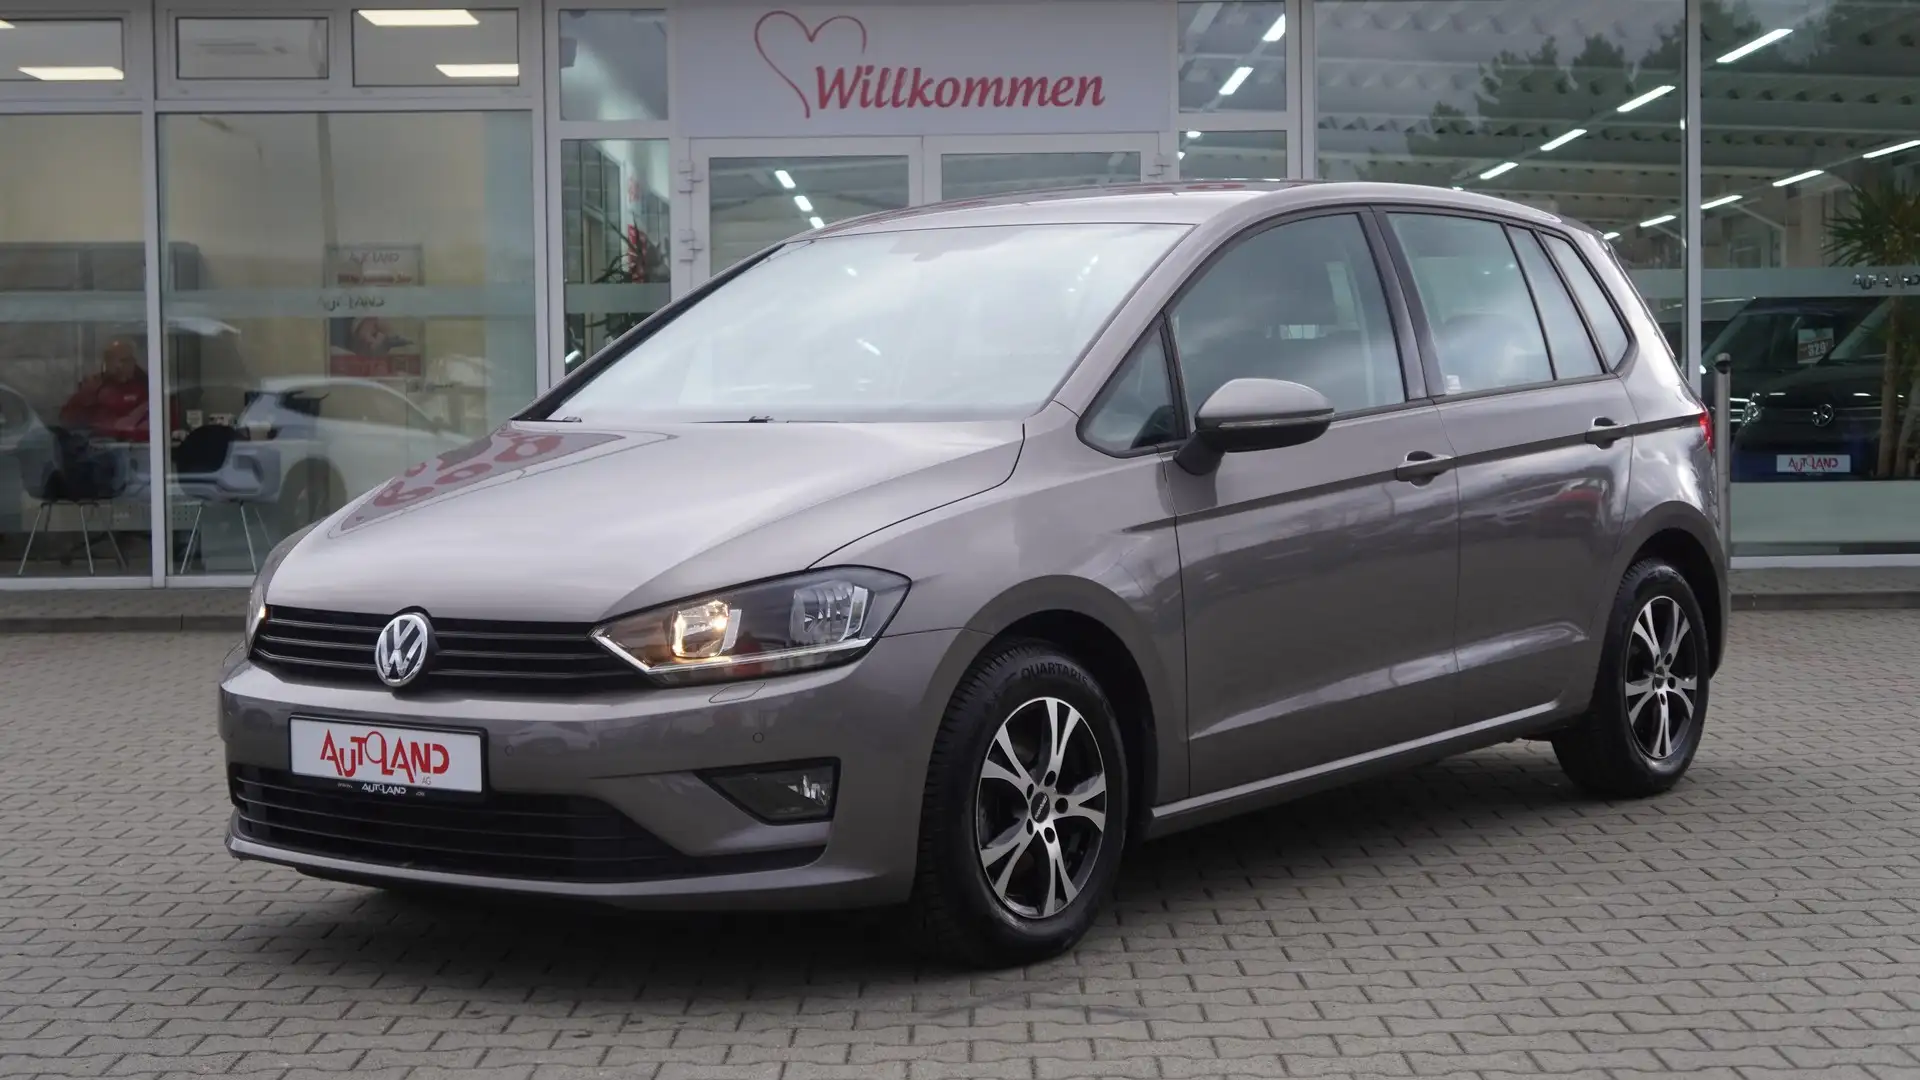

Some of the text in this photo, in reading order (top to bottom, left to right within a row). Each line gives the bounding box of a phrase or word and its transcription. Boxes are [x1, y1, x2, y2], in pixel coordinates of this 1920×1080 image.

[816, 65, 1105, 109] Willkommen
[1788, 455, 1839, 472] AUTOLAND
[320, 730, 449, 784] AUTOLAND
[361, 783, 406, 796] AUTOLAND
[421, 776, 431, 786] AG
